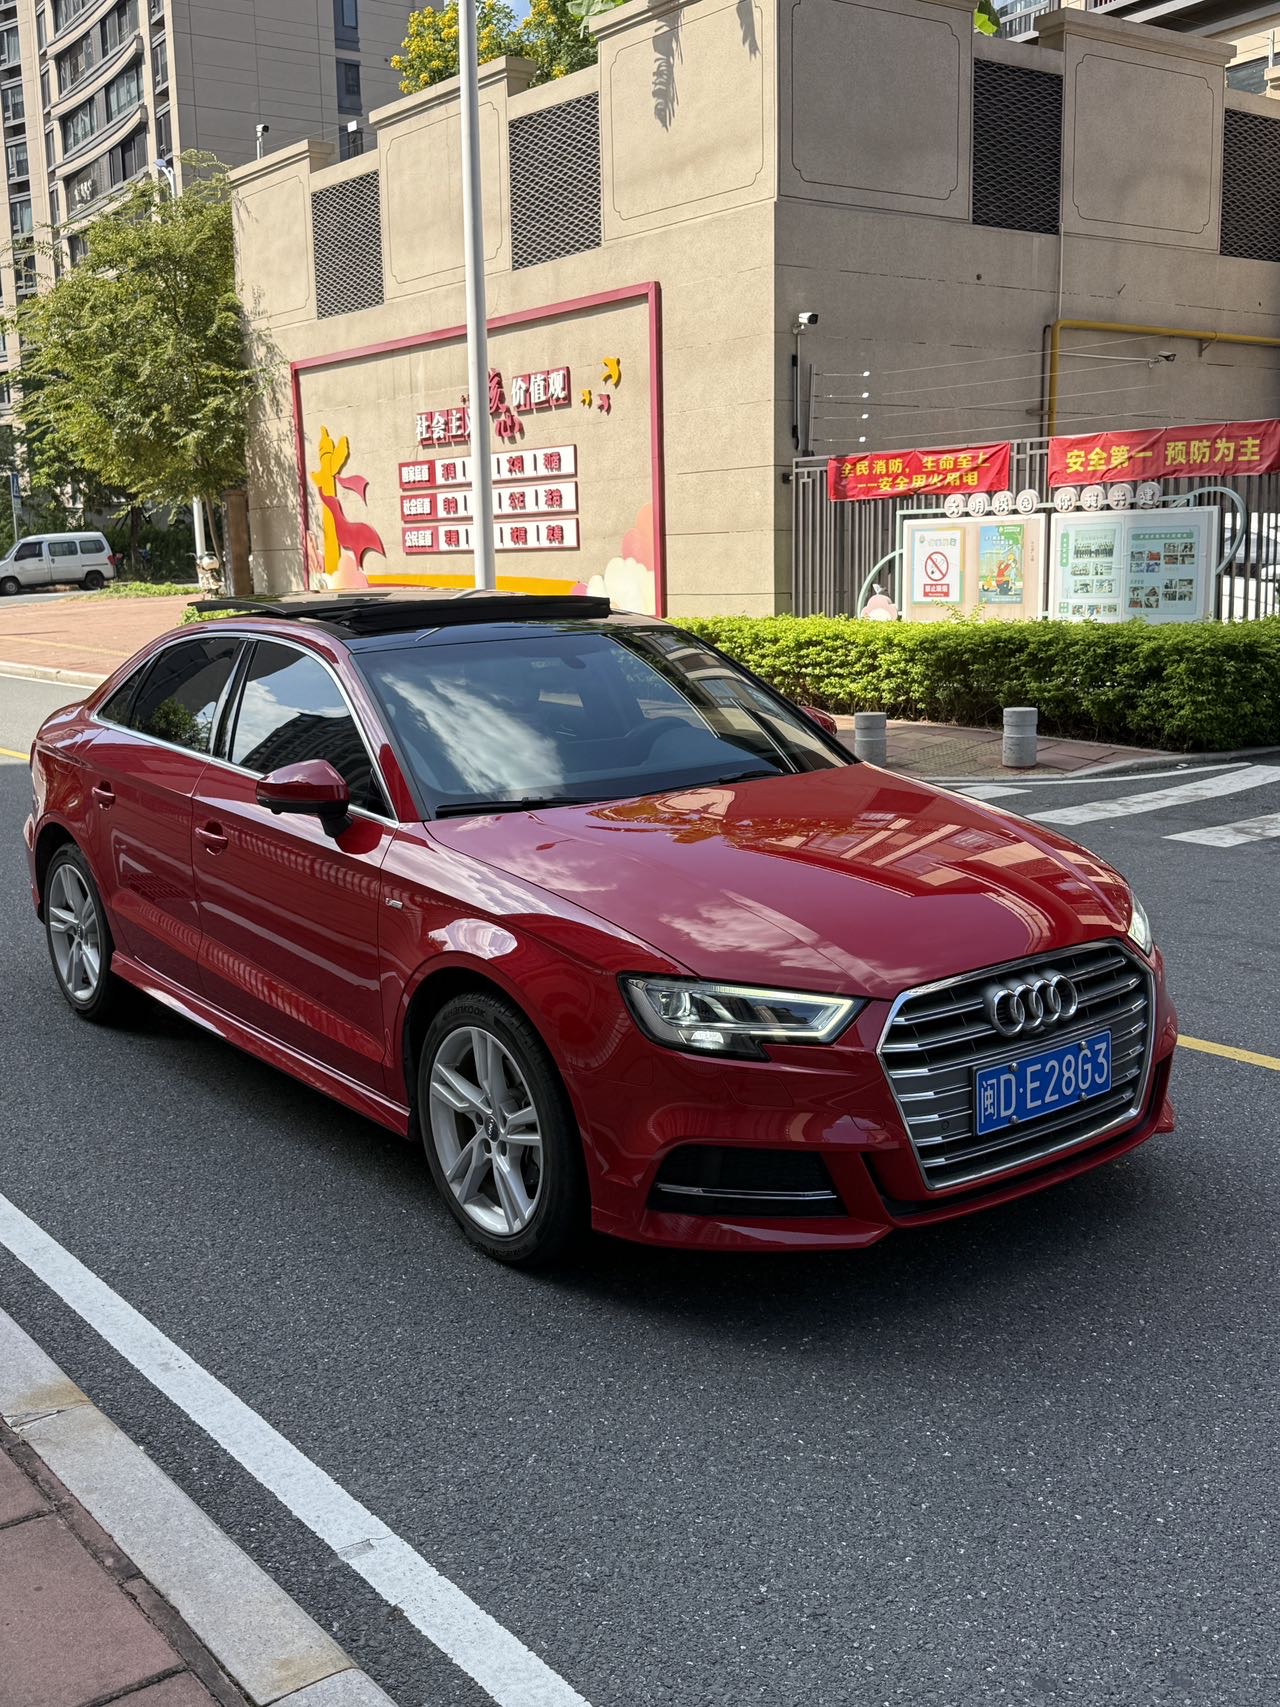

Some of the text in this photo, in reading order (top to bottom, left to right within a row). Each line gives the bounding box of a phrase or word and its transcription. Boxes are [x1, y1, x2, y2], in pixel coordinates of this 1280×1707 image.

[1065, 436, 1261, 474] 安全第一 预防为主
